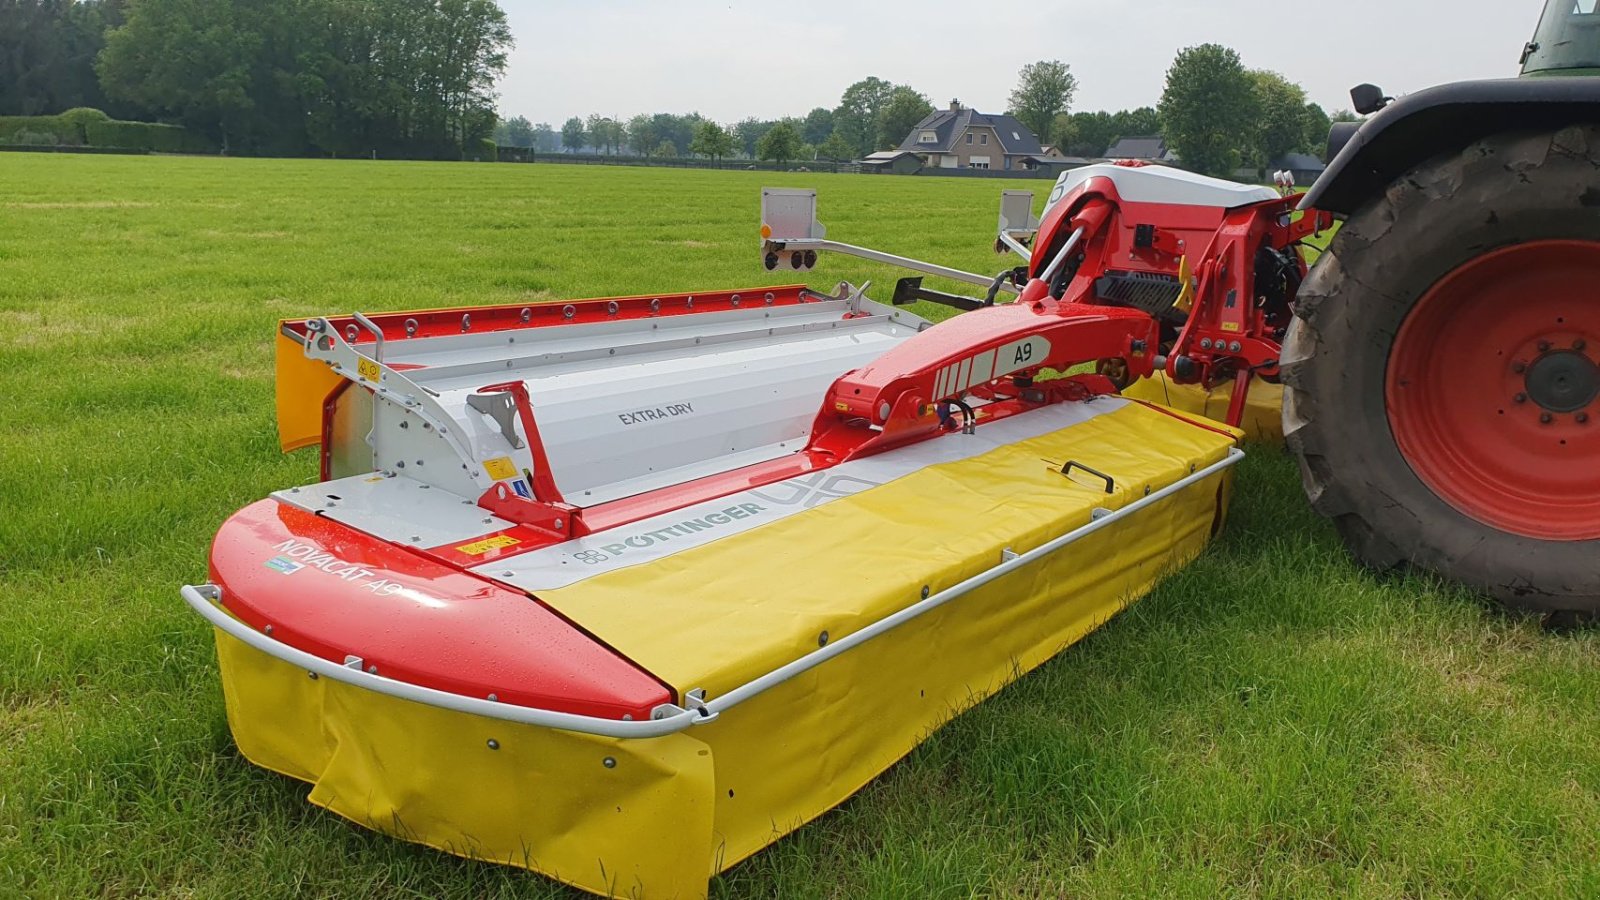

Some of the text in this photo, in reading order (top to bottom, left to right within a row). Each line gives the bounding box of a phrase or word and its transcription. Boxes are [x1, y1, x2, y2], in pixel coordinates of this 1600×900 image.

[1013, 342, 1032, 365] A9
[618, 402, 694, 425] EXTRA DRY
[272, 539, 375, 581] NOVACAT
[361, 578, 404, 596] A9
